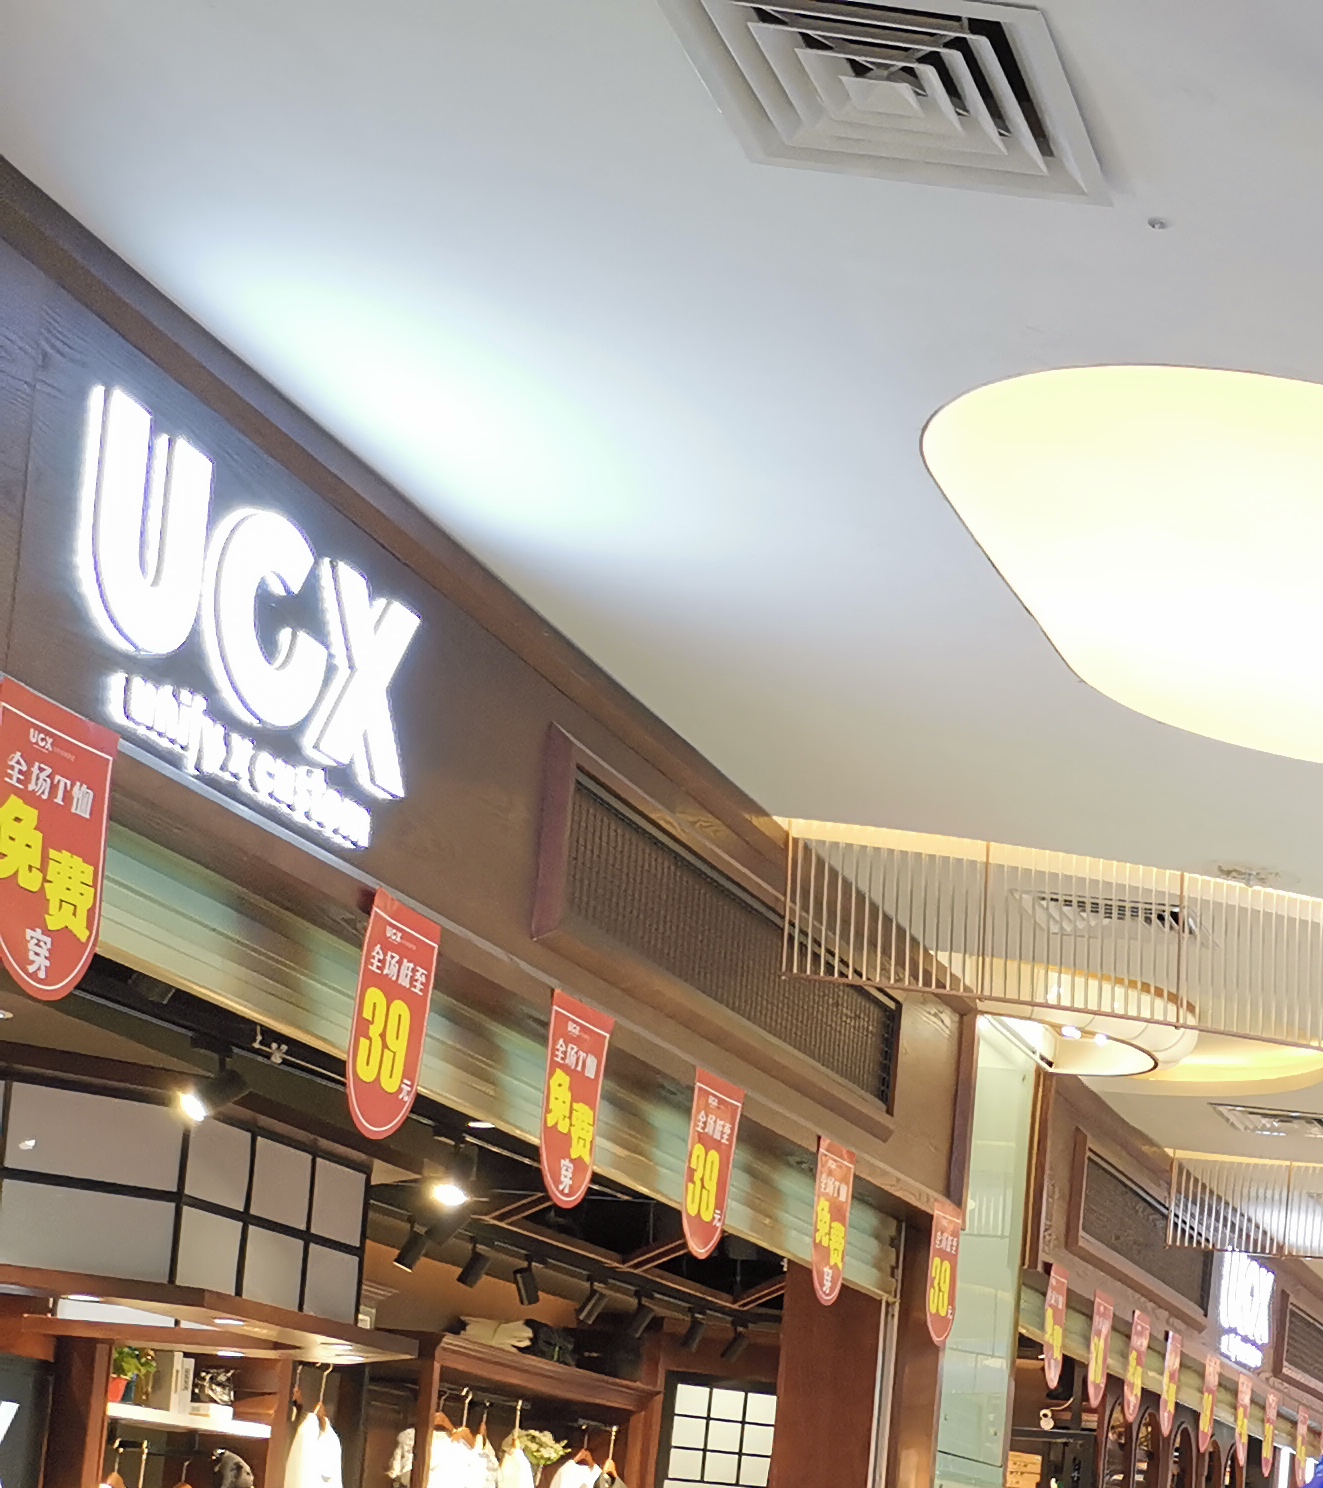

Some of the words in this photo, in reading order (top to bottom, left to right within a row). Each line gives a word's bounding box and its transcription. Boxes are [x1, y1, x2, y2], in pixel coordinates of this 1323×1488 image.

[76, 381, 424, 801] UCX
[29, 727, 54, 752] UCX
[4, 751, 95, 819] 全场T恤
[0, 794, 95, 943] 免费
[25, 928, 52, 979] 穿
[368, 943, 428, 996] 全场低至
[546, 1067, 595, 1166] 免费
